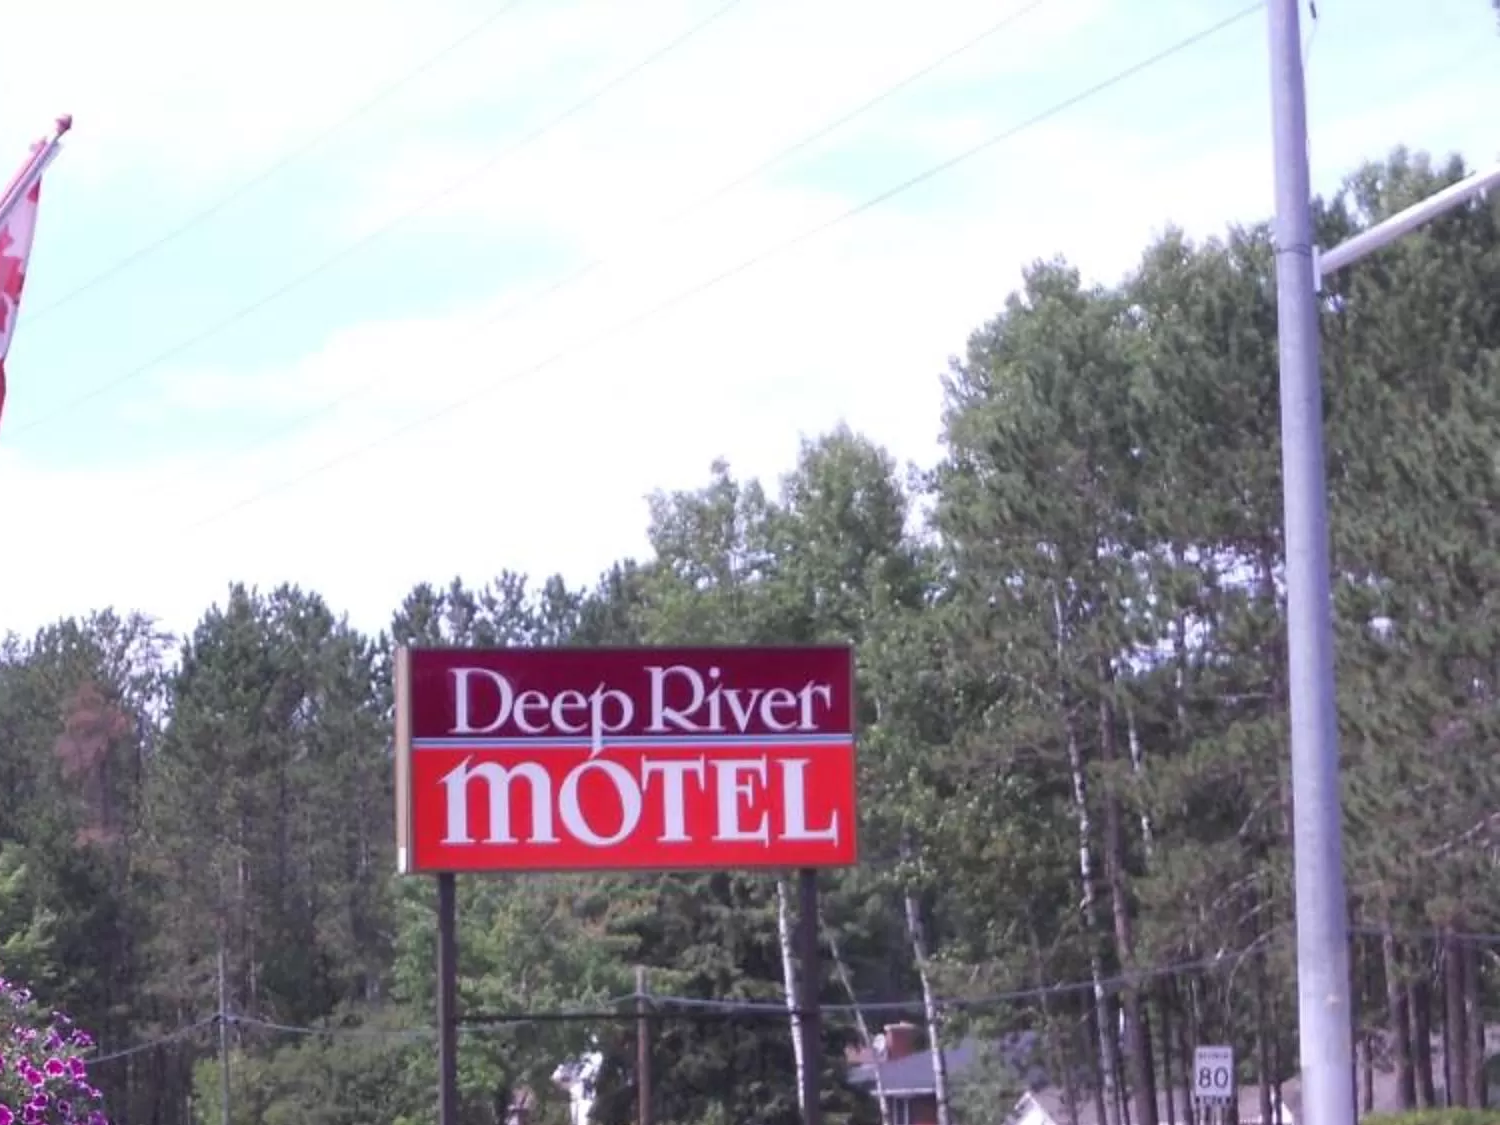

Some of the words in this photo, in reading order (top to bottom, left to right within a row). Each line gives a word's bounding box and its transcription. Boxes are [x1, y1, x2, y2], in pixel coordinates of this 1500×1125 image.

[448, 667, 635, 759] Deep
[644, 665, 831, 734] River
[1198, 1066, 1229, 1089] 80
